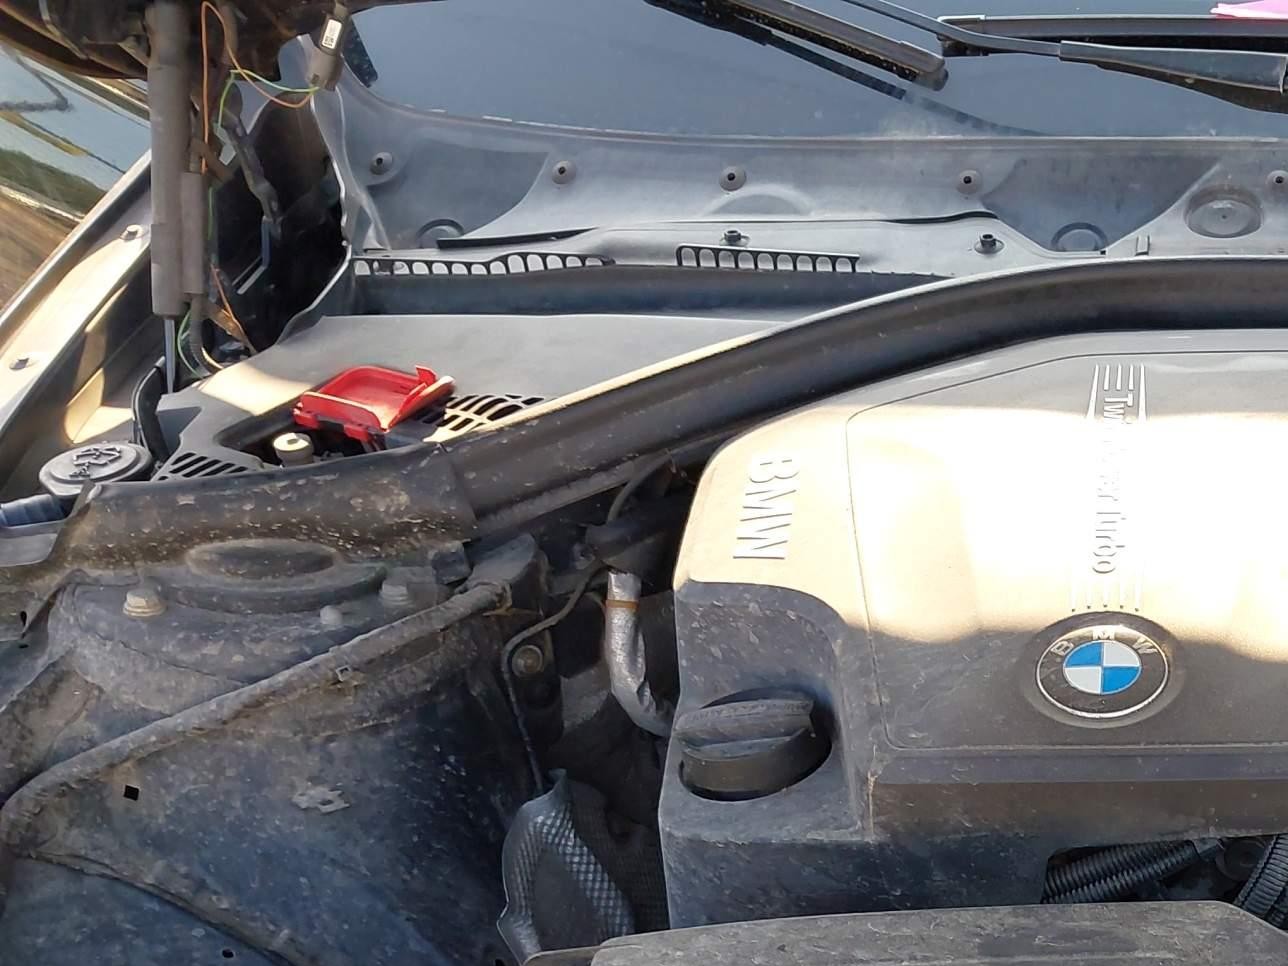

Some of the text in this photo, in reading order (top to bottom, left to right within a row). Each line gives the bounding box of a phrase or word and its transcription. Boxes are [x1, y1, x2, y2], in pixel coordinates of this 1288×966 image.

[732, 454, 800, 560] BMW
[1092, 505, 1128, 574] Turbo
[1050, 628, 1159, 657] BMW
